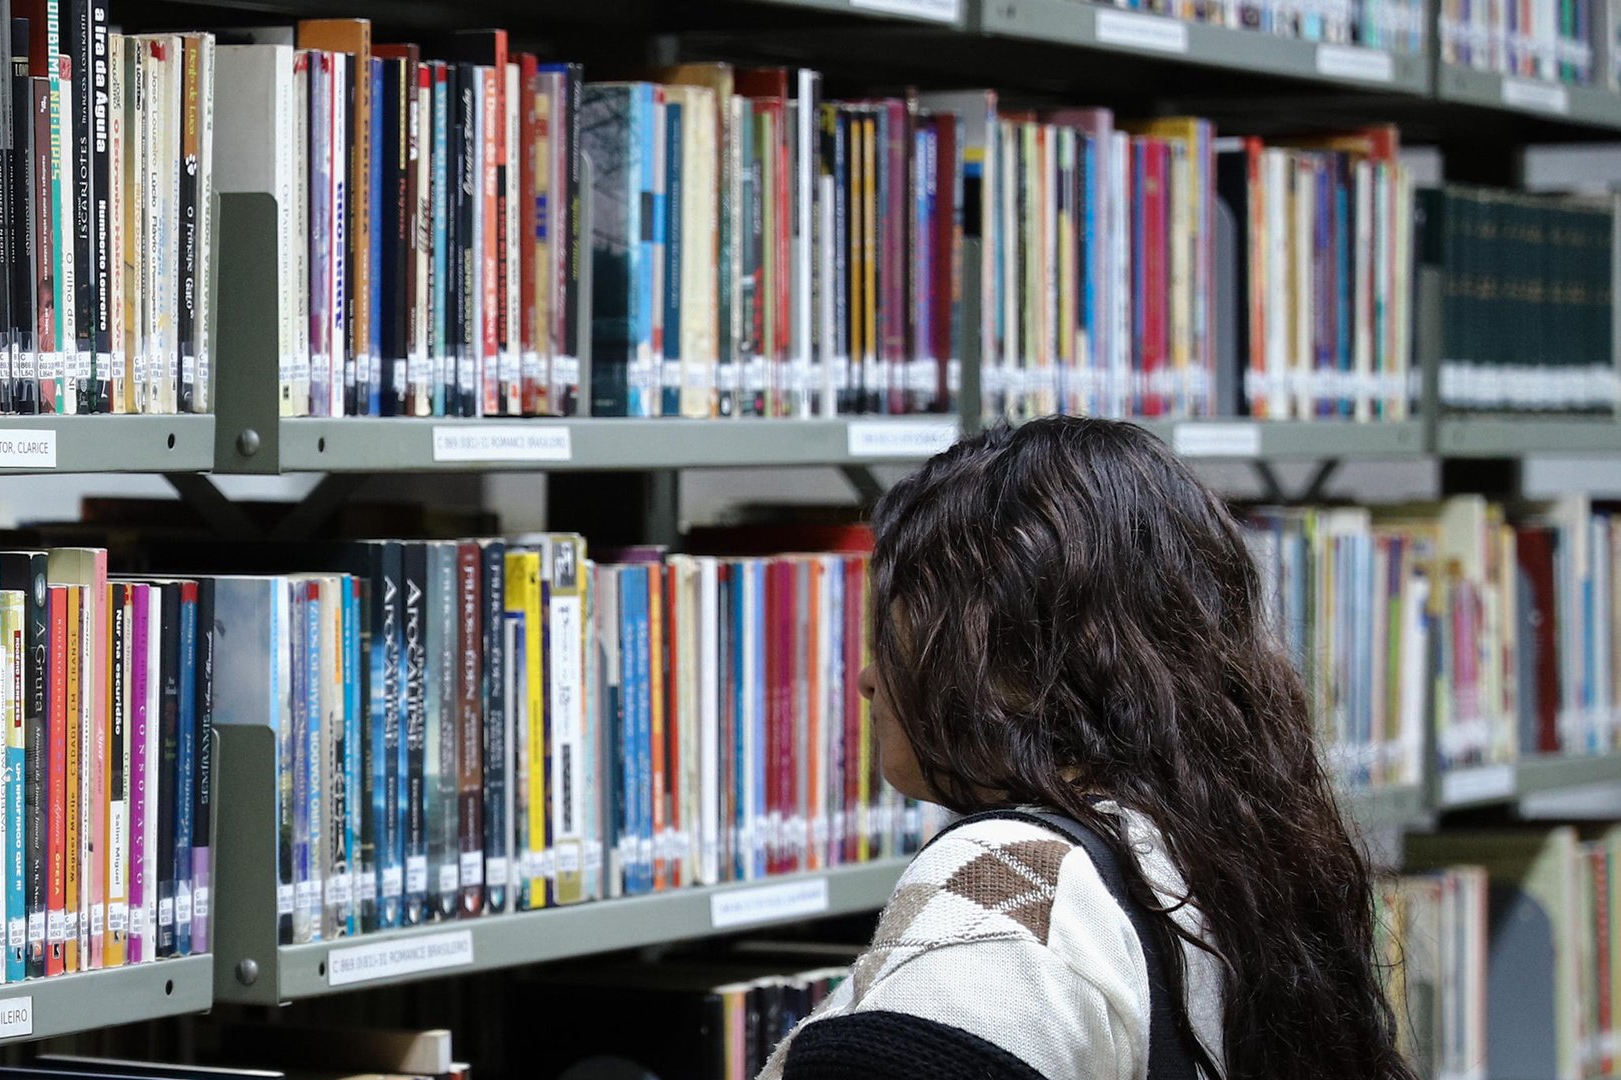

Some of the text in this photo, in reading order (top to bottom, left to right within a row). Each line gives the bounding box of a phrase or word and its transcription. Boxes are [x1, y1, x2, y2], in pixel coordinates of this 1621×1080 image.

[95, 7, 109, 331] a ira da Águia Humberto Loureiro
[186, 207, 193, 217] O
[66, 252, 73, 262] O
[67, 307, 74, 325] de
[18, 442, 48, 454] CLARICE
[33, 620, 46, 712] A Gruta
[112, 610, 124, 885] Nur na escuridão Salim Miguel
